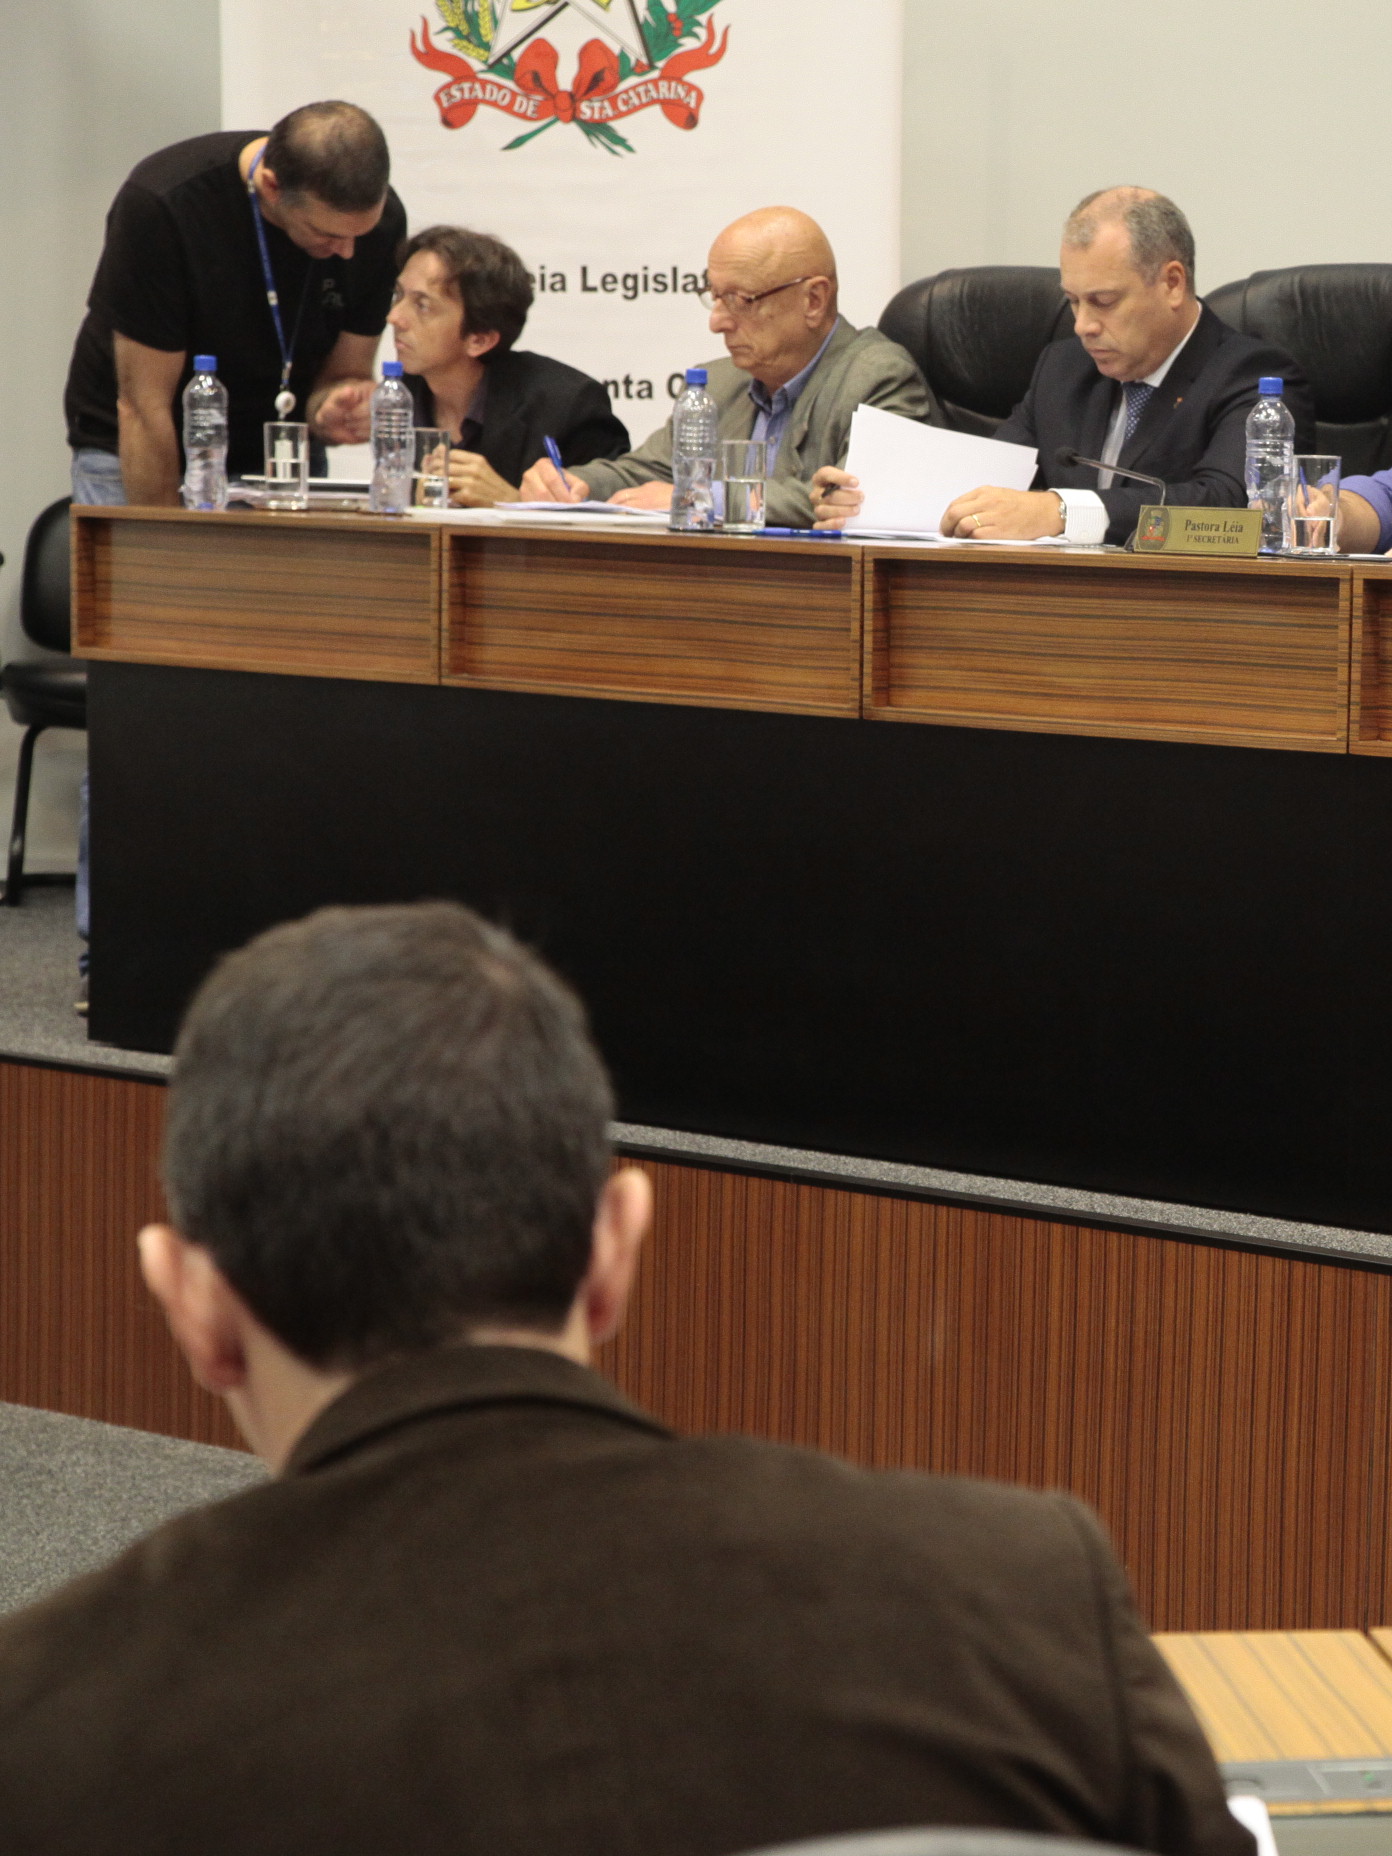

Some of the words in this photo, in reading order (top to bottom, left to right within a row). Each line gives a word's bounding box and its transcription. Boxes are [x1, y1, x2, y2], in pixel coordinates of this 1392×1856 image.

[438, 80, 510, 109] ESTADO
[512, 98, 538, 118] DE
[617, 80, 698, 110] CATARINA
[1185, 519, 1220, 532] Pastora
